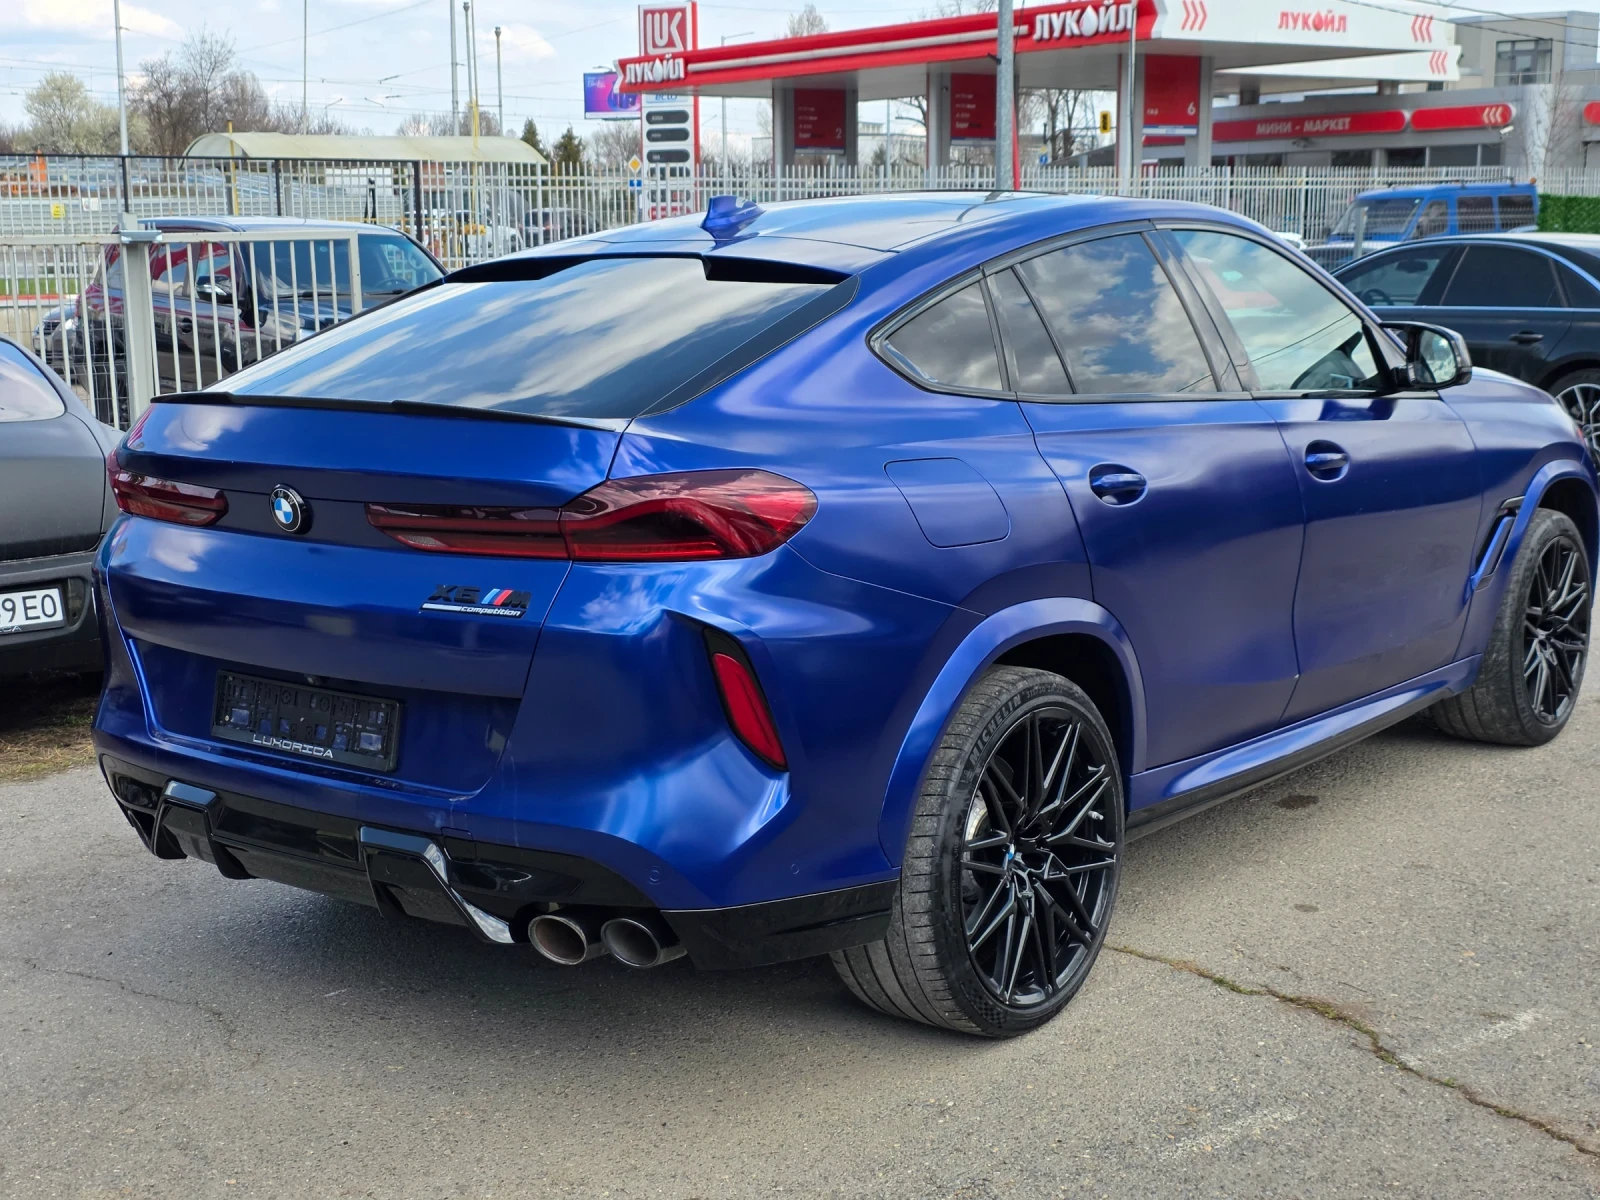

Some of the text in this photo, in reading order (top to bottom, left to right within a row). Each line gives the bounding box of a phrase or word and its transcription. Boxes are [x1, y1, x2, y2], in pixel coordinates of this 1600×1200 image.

[1187, 102, 1196, 116] 6
[836, 128, 842, 139] 2
[1256, 121, 1292, 135] МИНИ
[1303, 118, 1351, 133] МАРКЕТ
[460, 606, 521, 617] competition
[969, 693, 1022, 766] MICHELIN
[252, 734, 334, 759] LUXORICA
